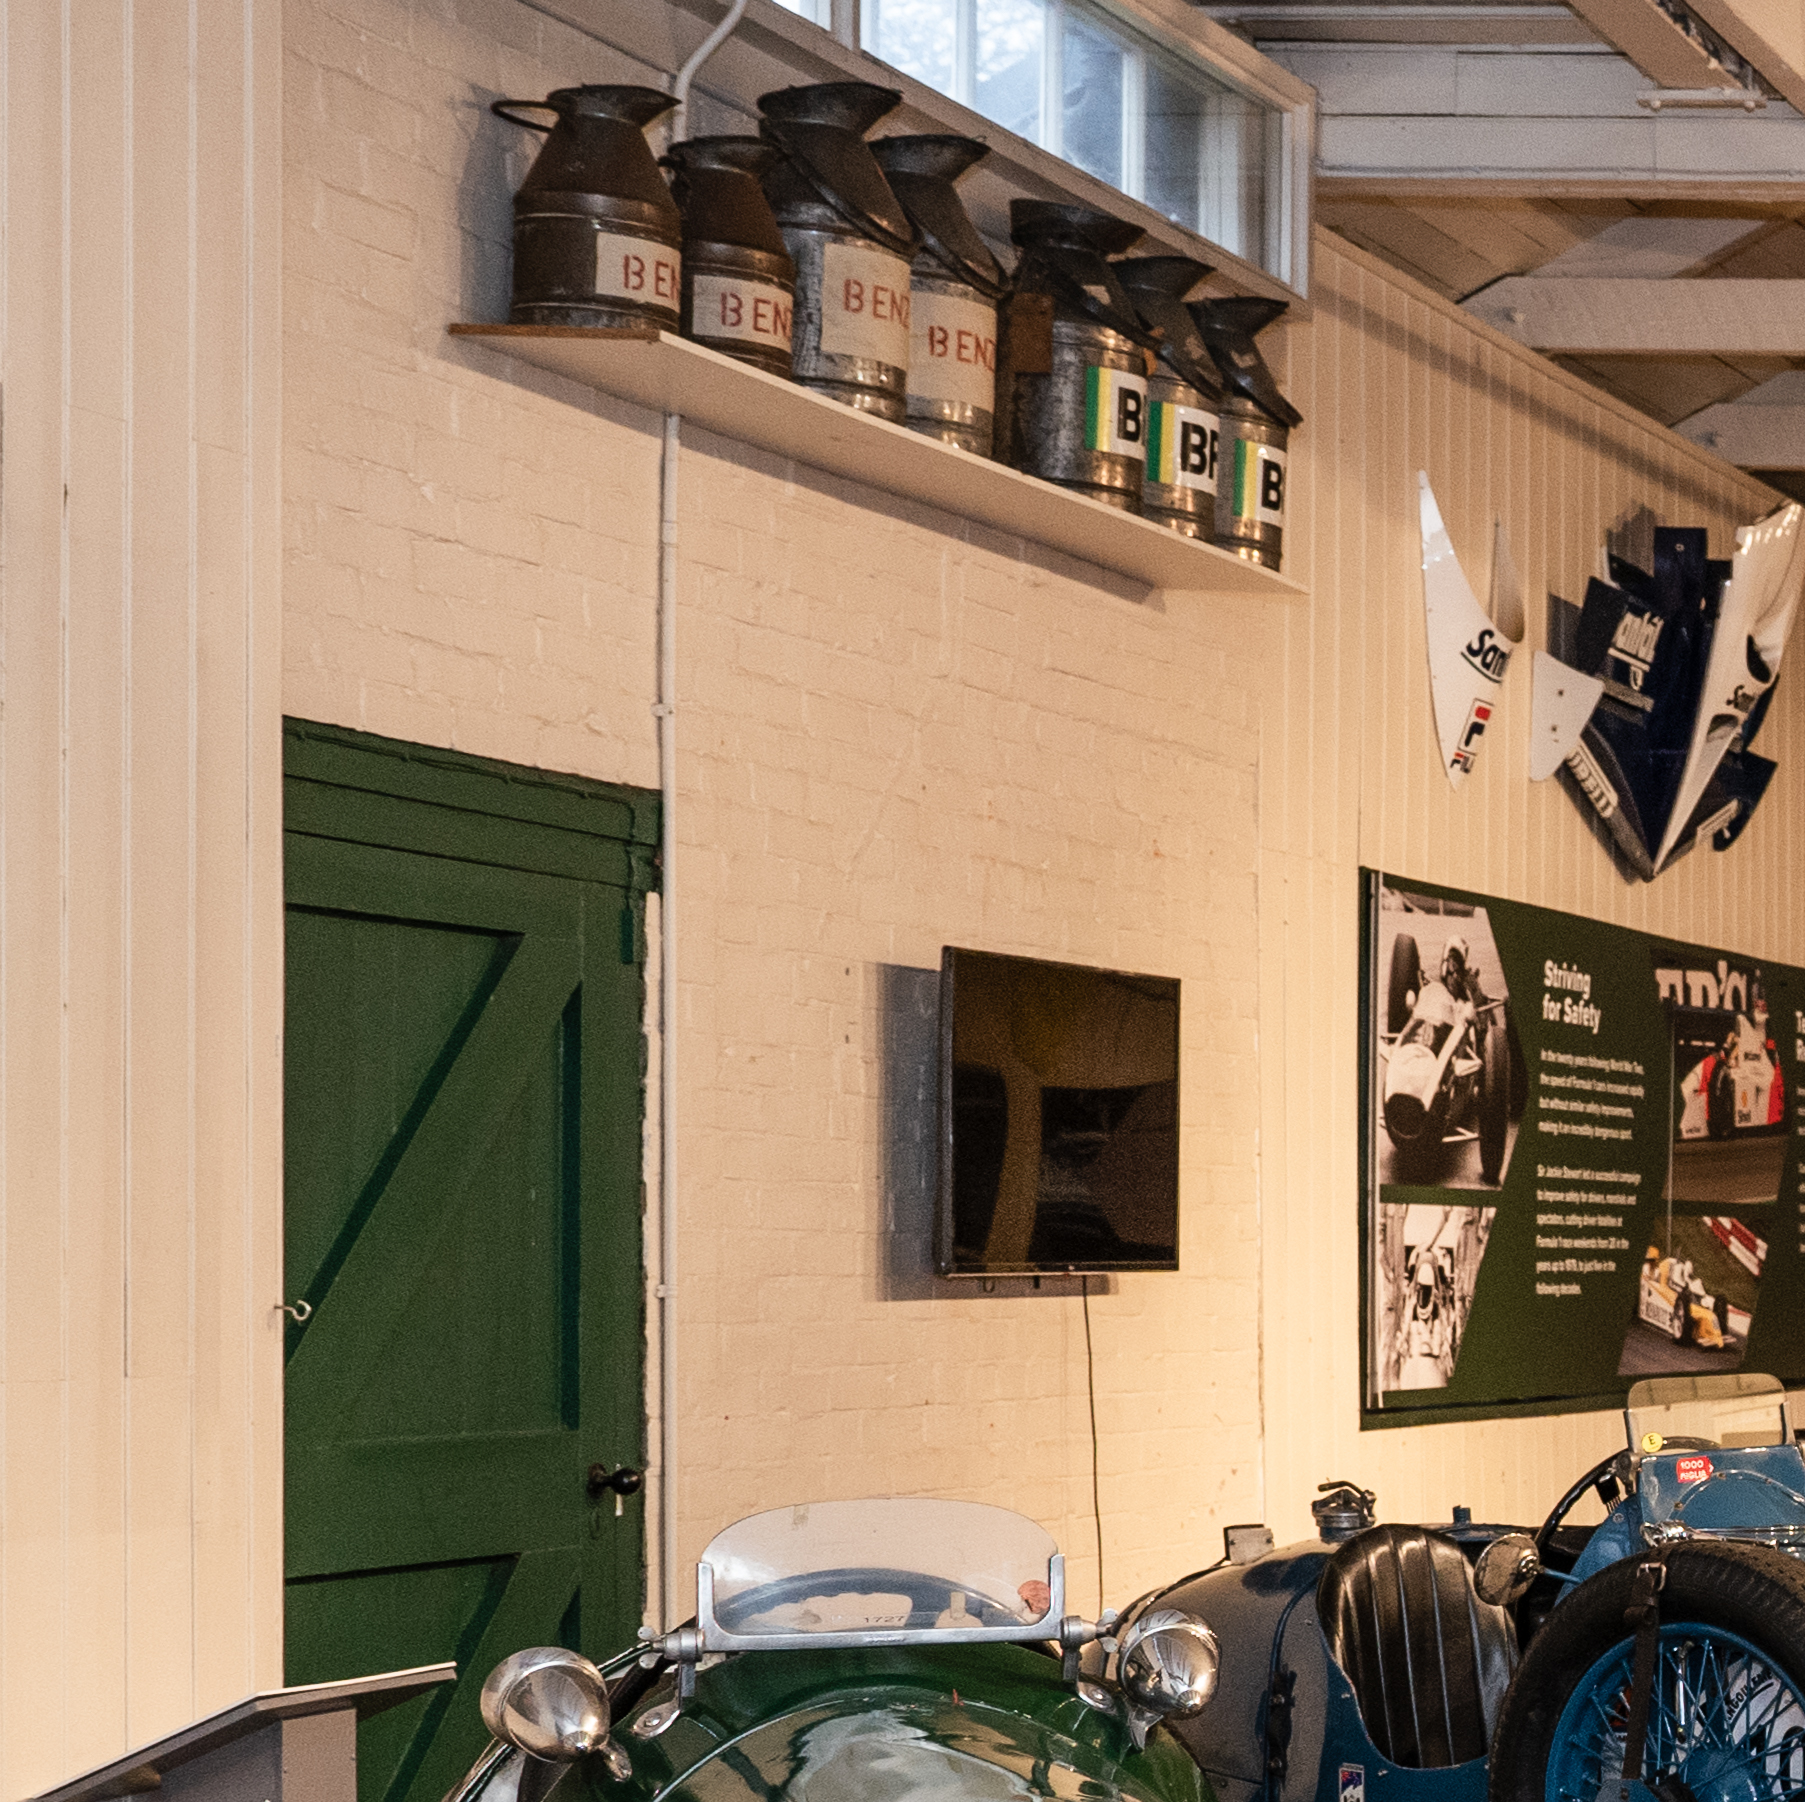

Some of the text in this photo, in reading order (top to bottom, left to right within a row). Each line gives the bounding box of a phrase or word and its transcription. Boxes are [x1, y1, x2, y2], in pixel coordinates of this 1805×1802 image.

[1543, 959, 1592, 1001] Striving
[1542, 993, 1602, 1035] for Safety
[1679, 1459, 1705, 1470] 1000
